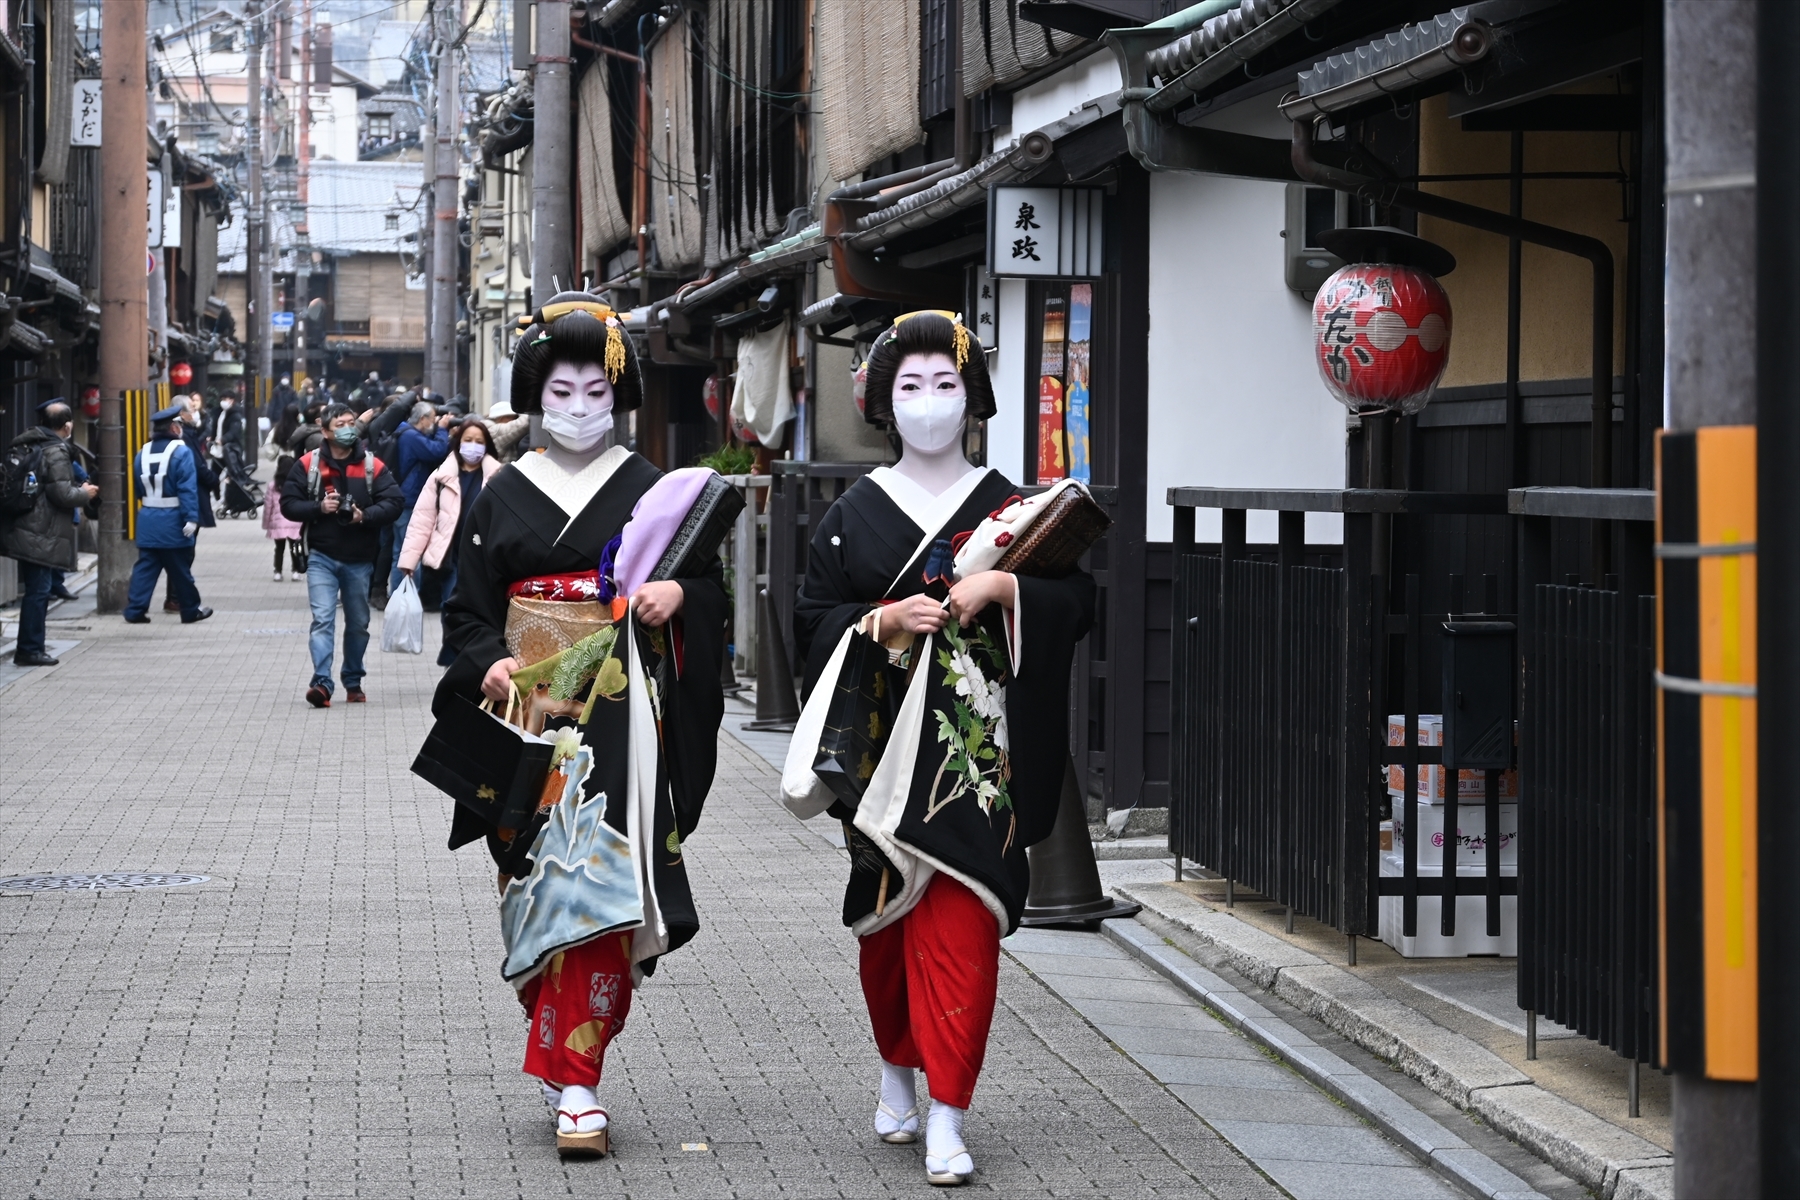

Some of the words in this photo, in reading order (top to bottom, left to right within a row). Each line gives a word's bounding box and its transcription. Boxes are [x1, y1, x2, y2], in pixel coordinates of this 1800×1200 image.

[81, 88, 98, 139] おかだ
[1011, 201, 1041, 262] 泉政
[979, 284, 993, 325] 泉政
[1458, 780, 1505, 789] 向山果
